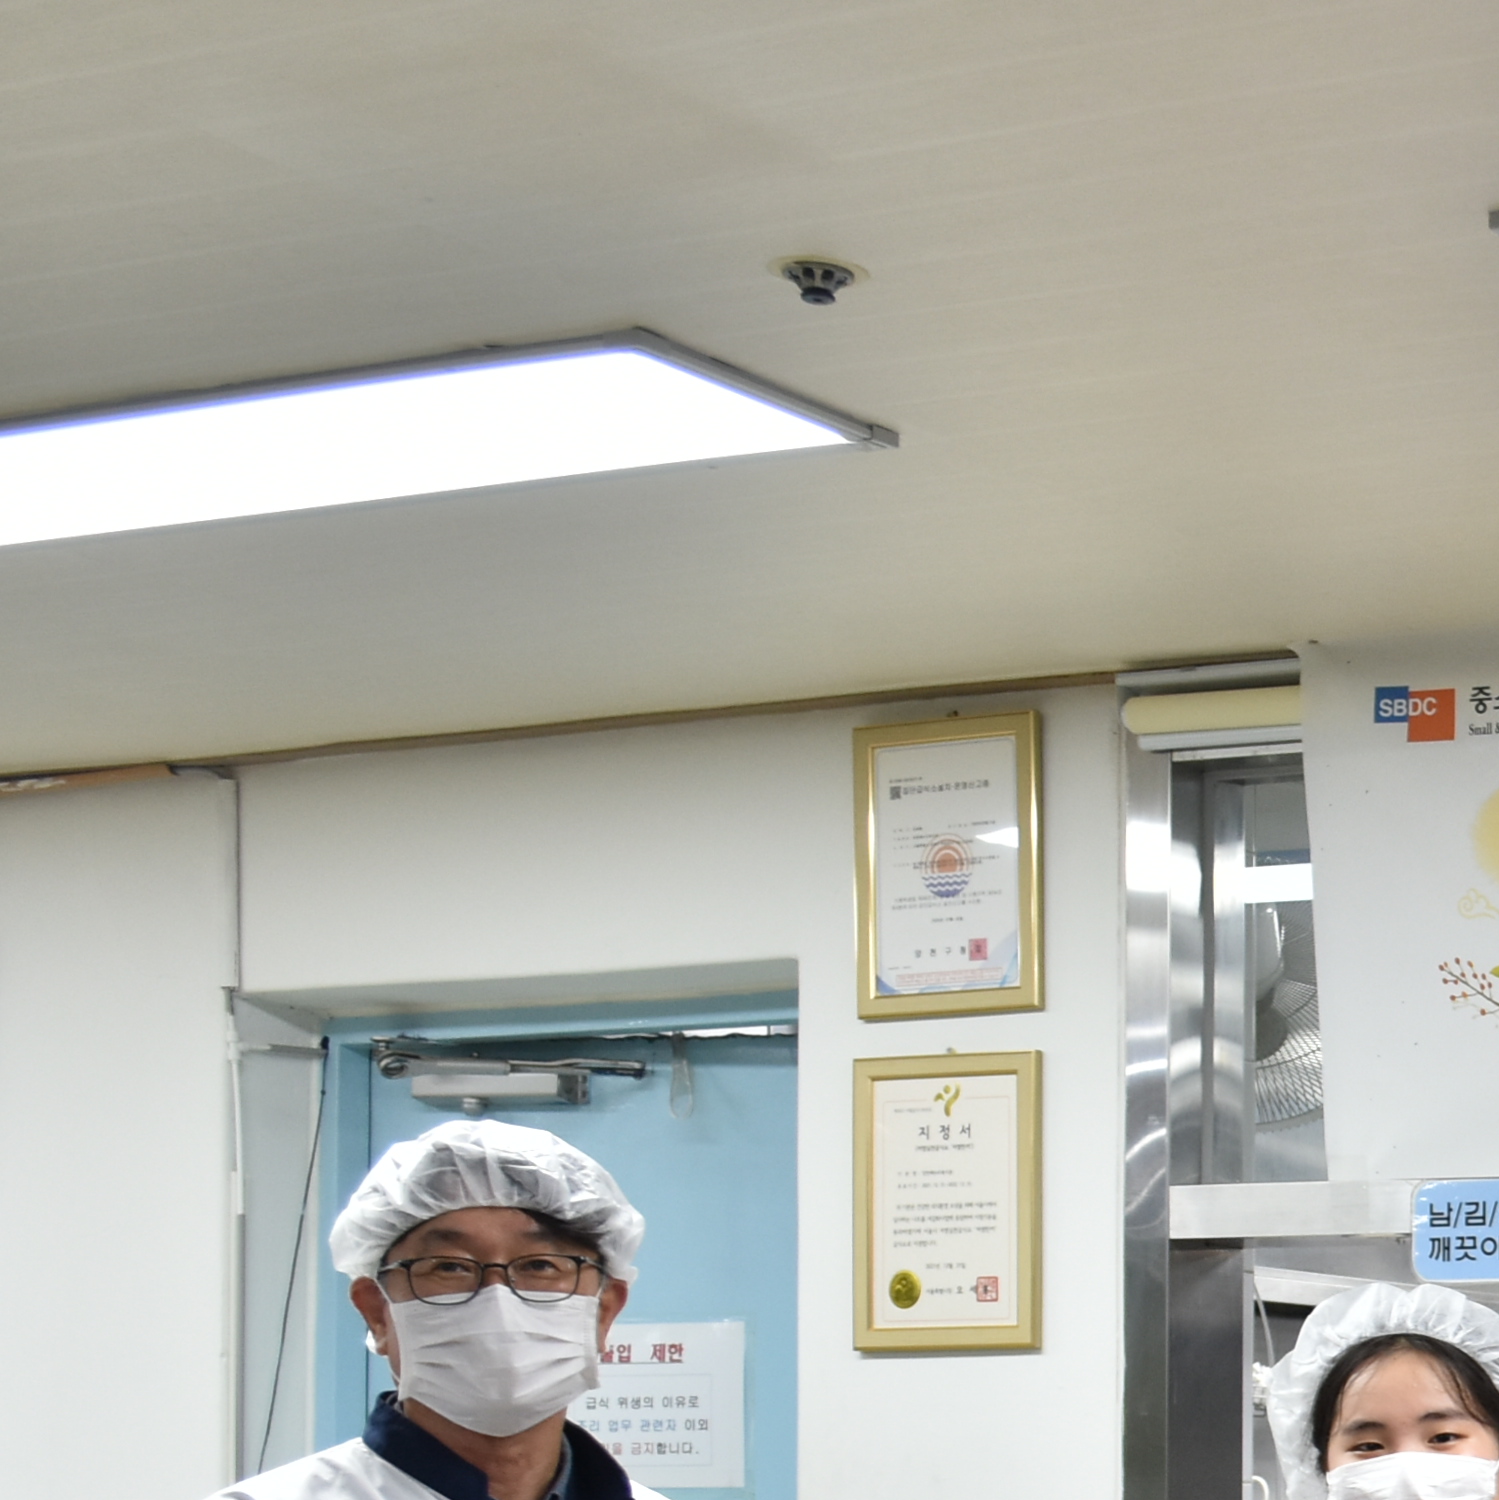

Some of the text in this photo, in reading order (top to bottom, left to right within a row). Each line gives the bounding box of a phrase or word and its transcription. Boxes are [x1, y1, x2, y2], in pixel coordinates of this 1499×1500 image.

[1378, 697, 1438, 718] SBDC
[1468, 723, 1493, 736] Small
[650, 1343, 684, 1363] 제한
[586, 1395, 700, 1410] 급식 위생의 이유로
[608, 1420, 632, 1432] 업무
[640, 1419, 676, 1432] 관련자
[685, 1418, 709, 1432] 이외
[631, 1442, 699, 1456] 금지합니다.
